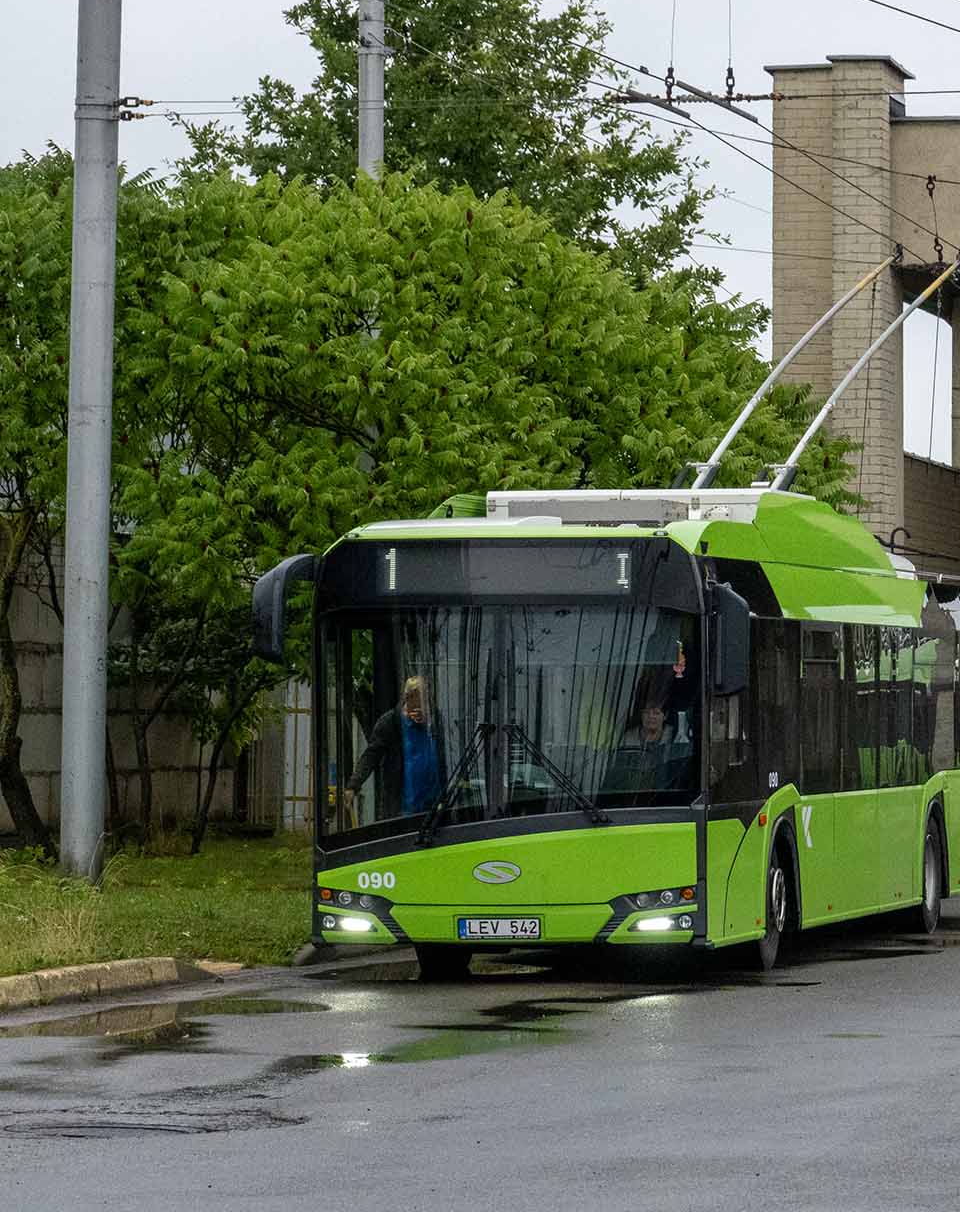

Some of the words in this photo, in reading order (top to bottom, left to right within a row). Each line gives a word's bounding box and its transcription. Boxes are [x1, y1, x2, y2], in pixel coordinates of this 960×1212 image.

[385, 548, 396, 589] 1
[768, 773, 779, 788] 090
[358, 872, 396, 888] 090
[468, 921, 500, 934] LEV
[510, 921, 537, 934] 542
